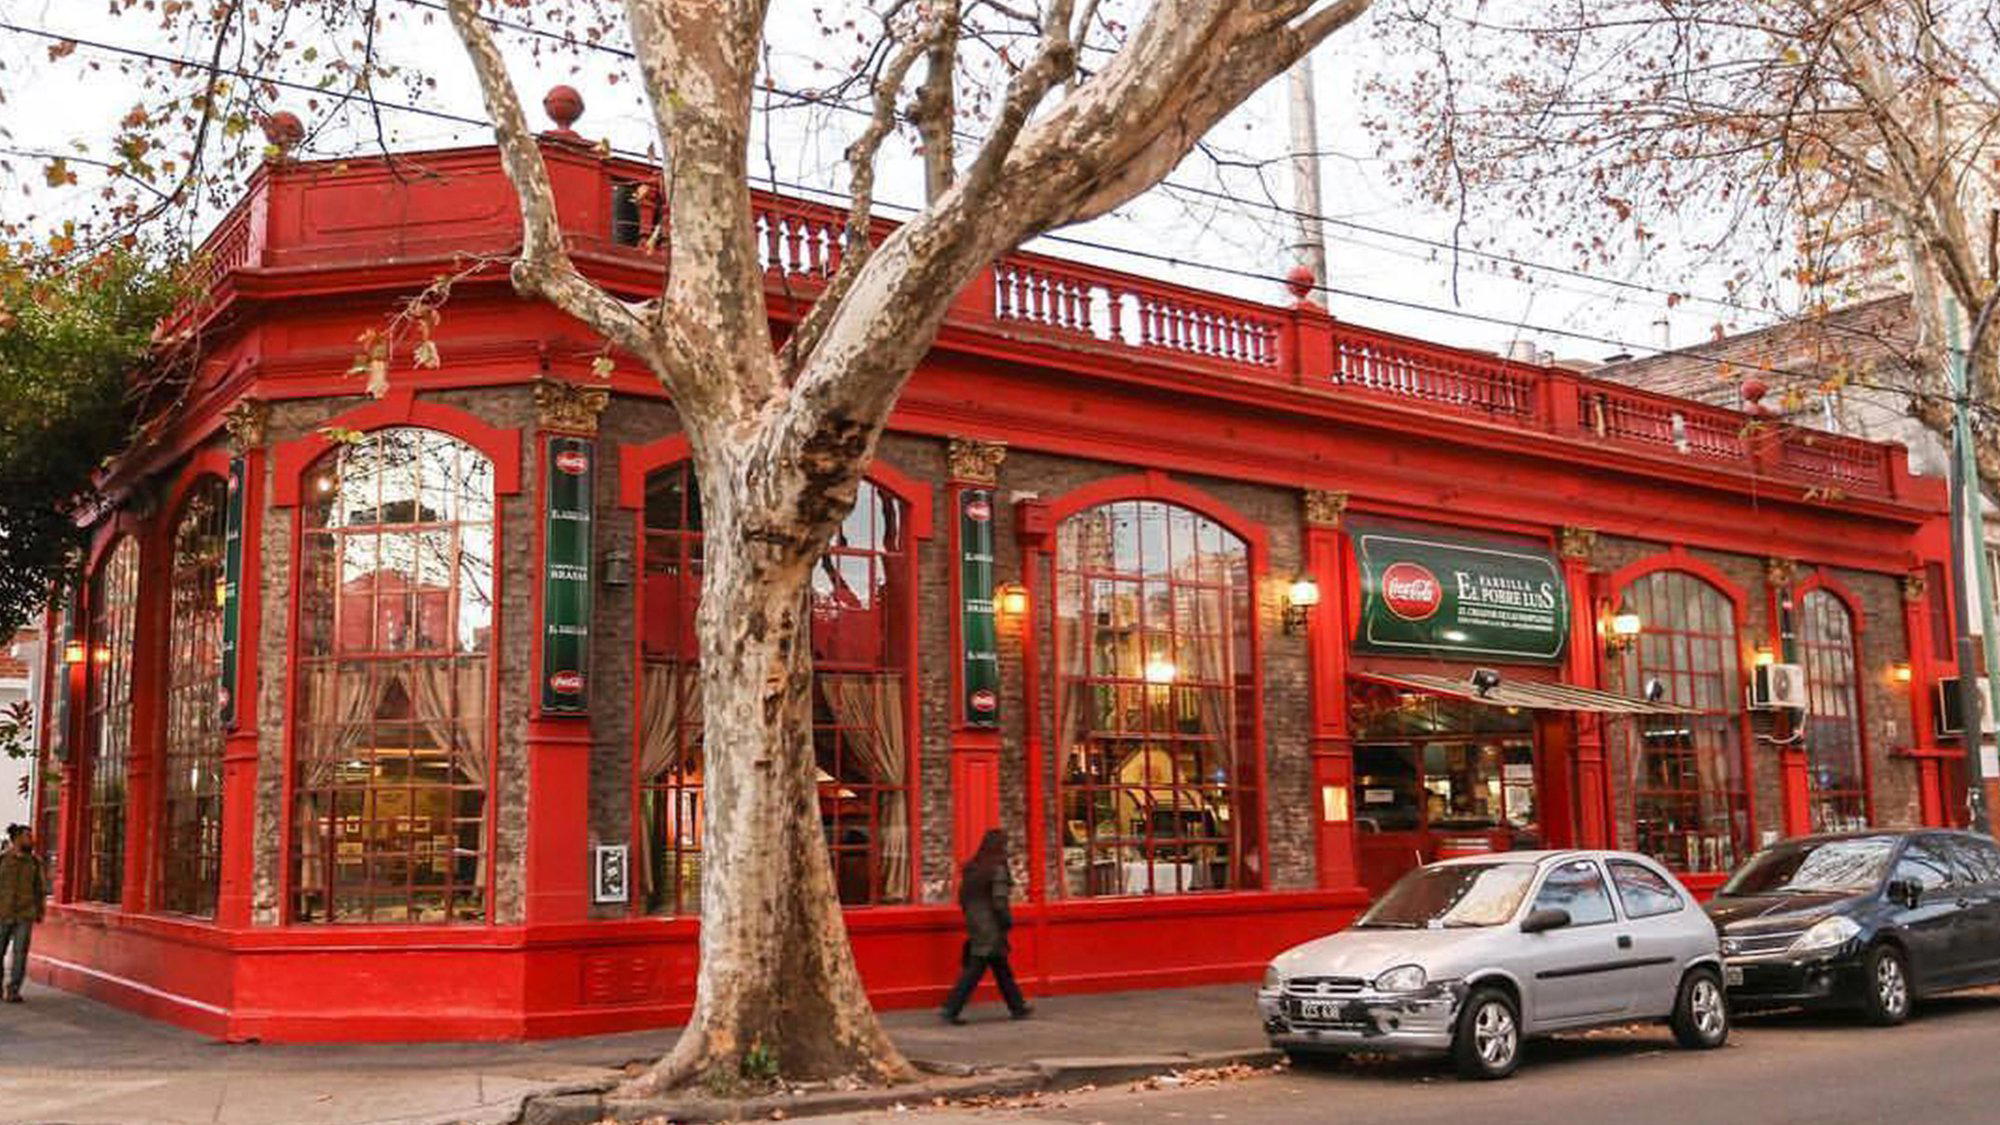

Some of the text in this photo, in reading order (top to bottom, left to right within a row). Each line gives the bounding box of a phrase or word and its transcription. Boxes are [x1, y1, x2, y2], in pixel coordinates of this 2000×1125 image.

[1455, 571, 1554, 609] EL POBRE LUIS
